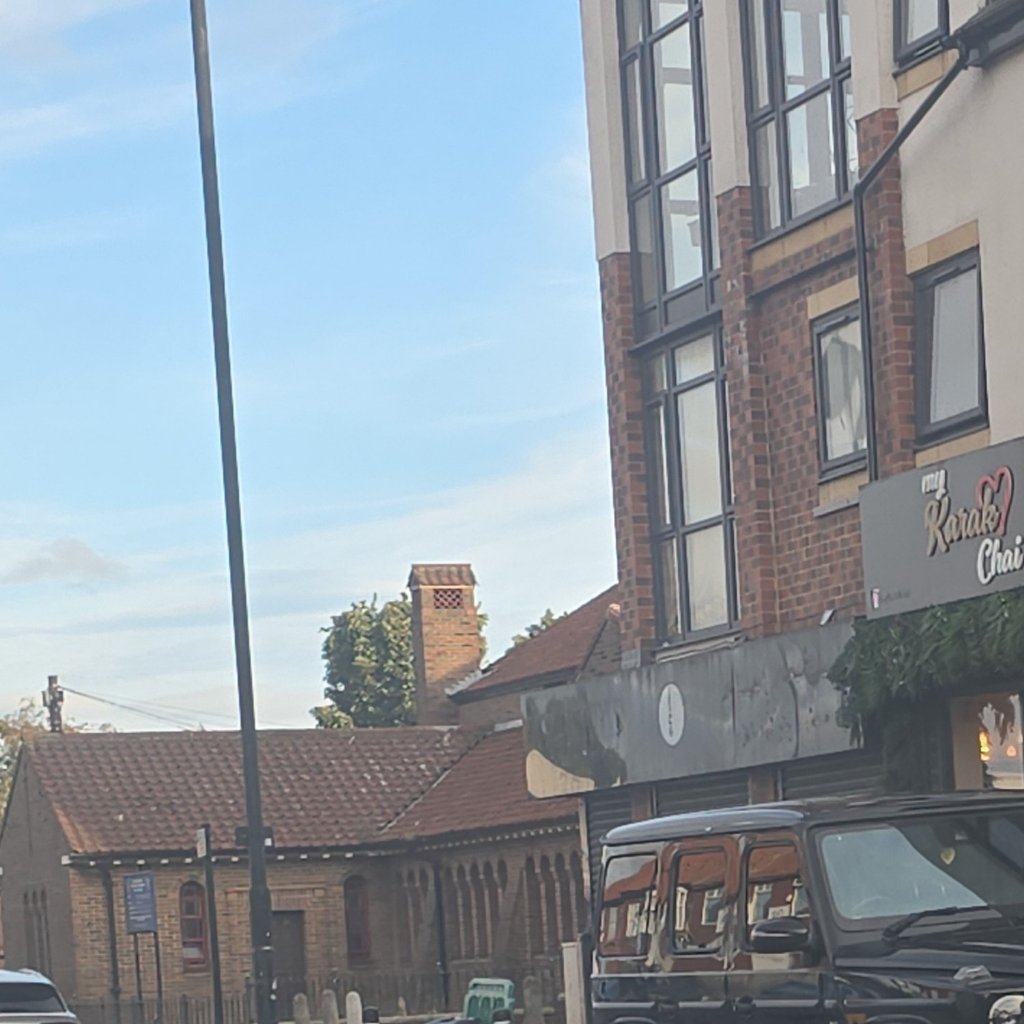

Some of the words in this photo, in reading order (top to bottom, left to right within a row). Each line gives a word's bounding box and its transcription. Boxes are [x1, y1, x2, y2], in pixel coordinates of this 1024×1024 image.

[922, 469, 947, 500] my
[925, 487, 1000, 557] Karak
[977, 535, 1024, 585] Chai
